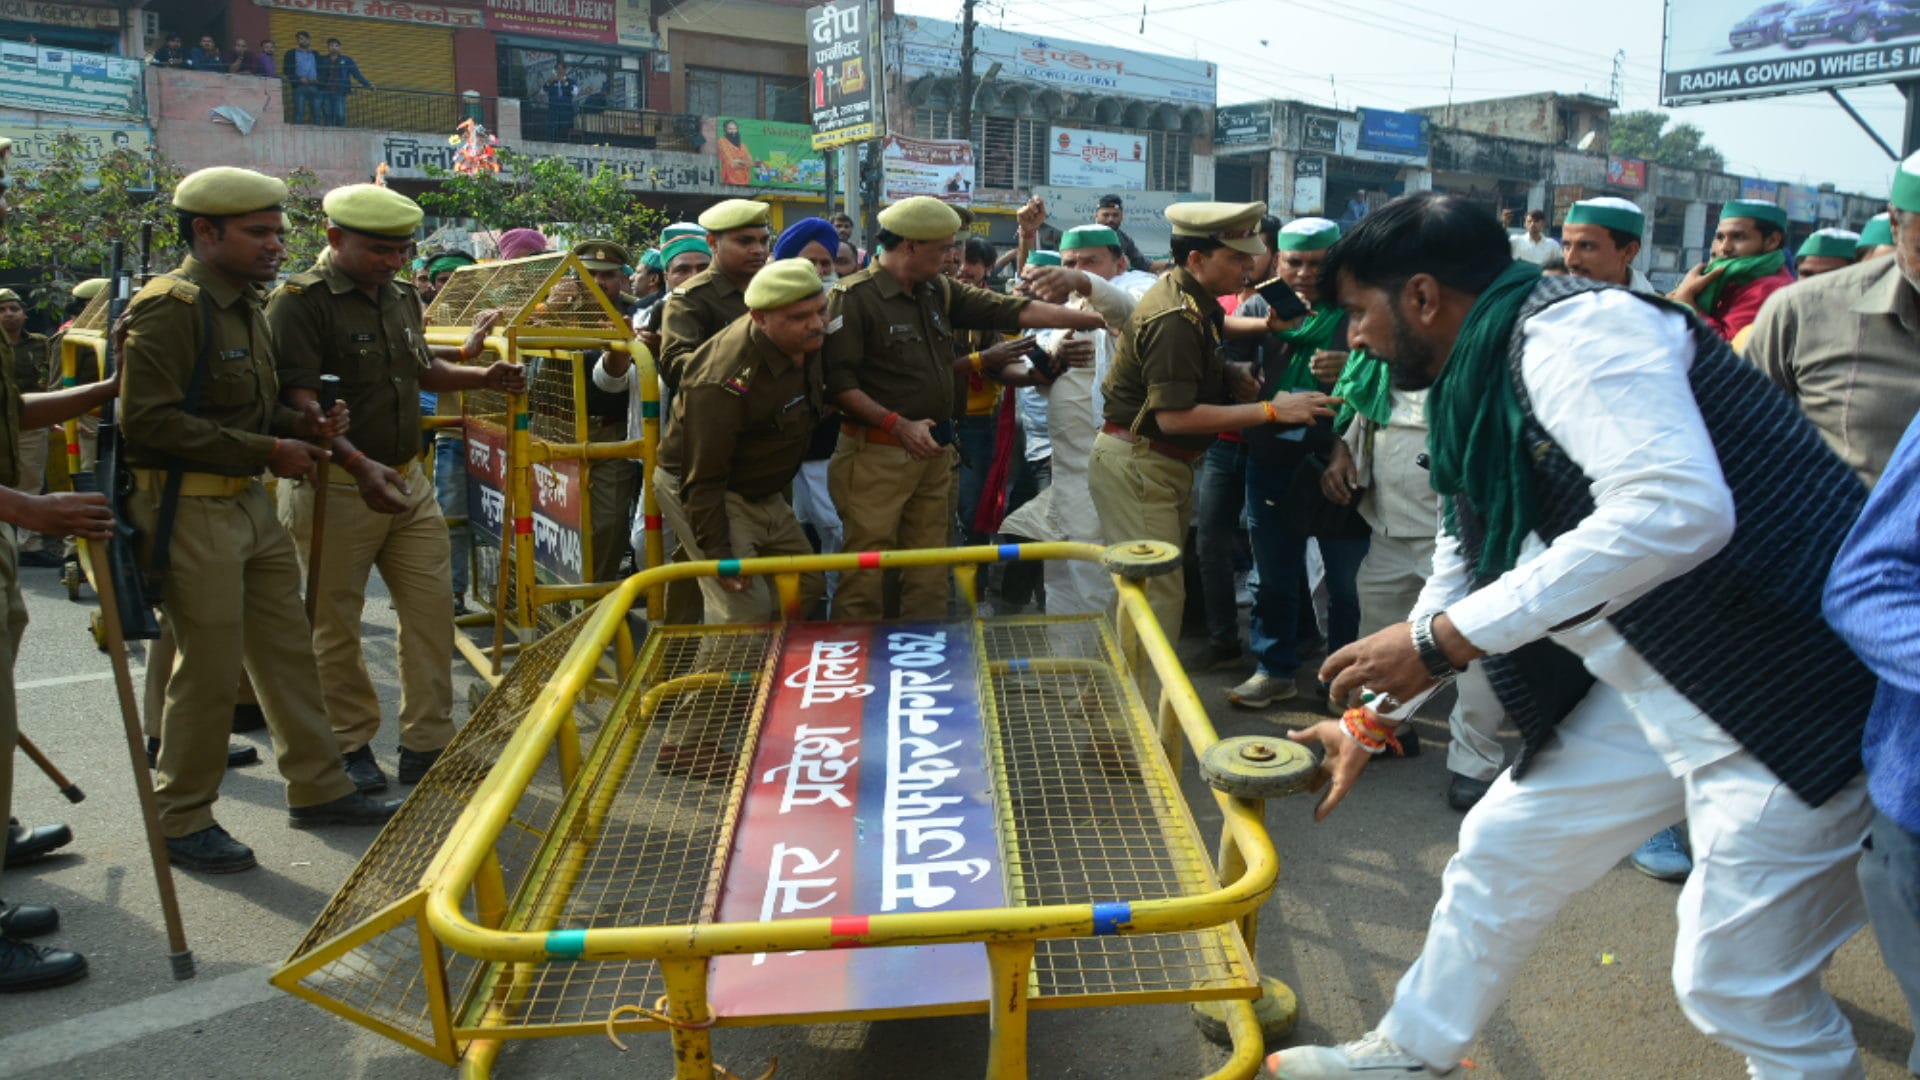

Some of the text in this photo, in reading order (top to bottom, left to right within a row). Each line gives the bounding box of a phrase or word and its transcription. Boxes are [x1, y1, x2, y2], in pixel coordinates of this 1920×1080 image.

[813, 5, 860, 43] दीप
[1679, 69, 1741, 92] RADHA
[1744, 59, 1815, 83] GOVIND
[1820, 49, 1903, 75] WHEELS
[888, 631, 948, 668] 052
[785, 640, 875, 709] पुलिस
[762, 723, 860, 815] प्रदेश
